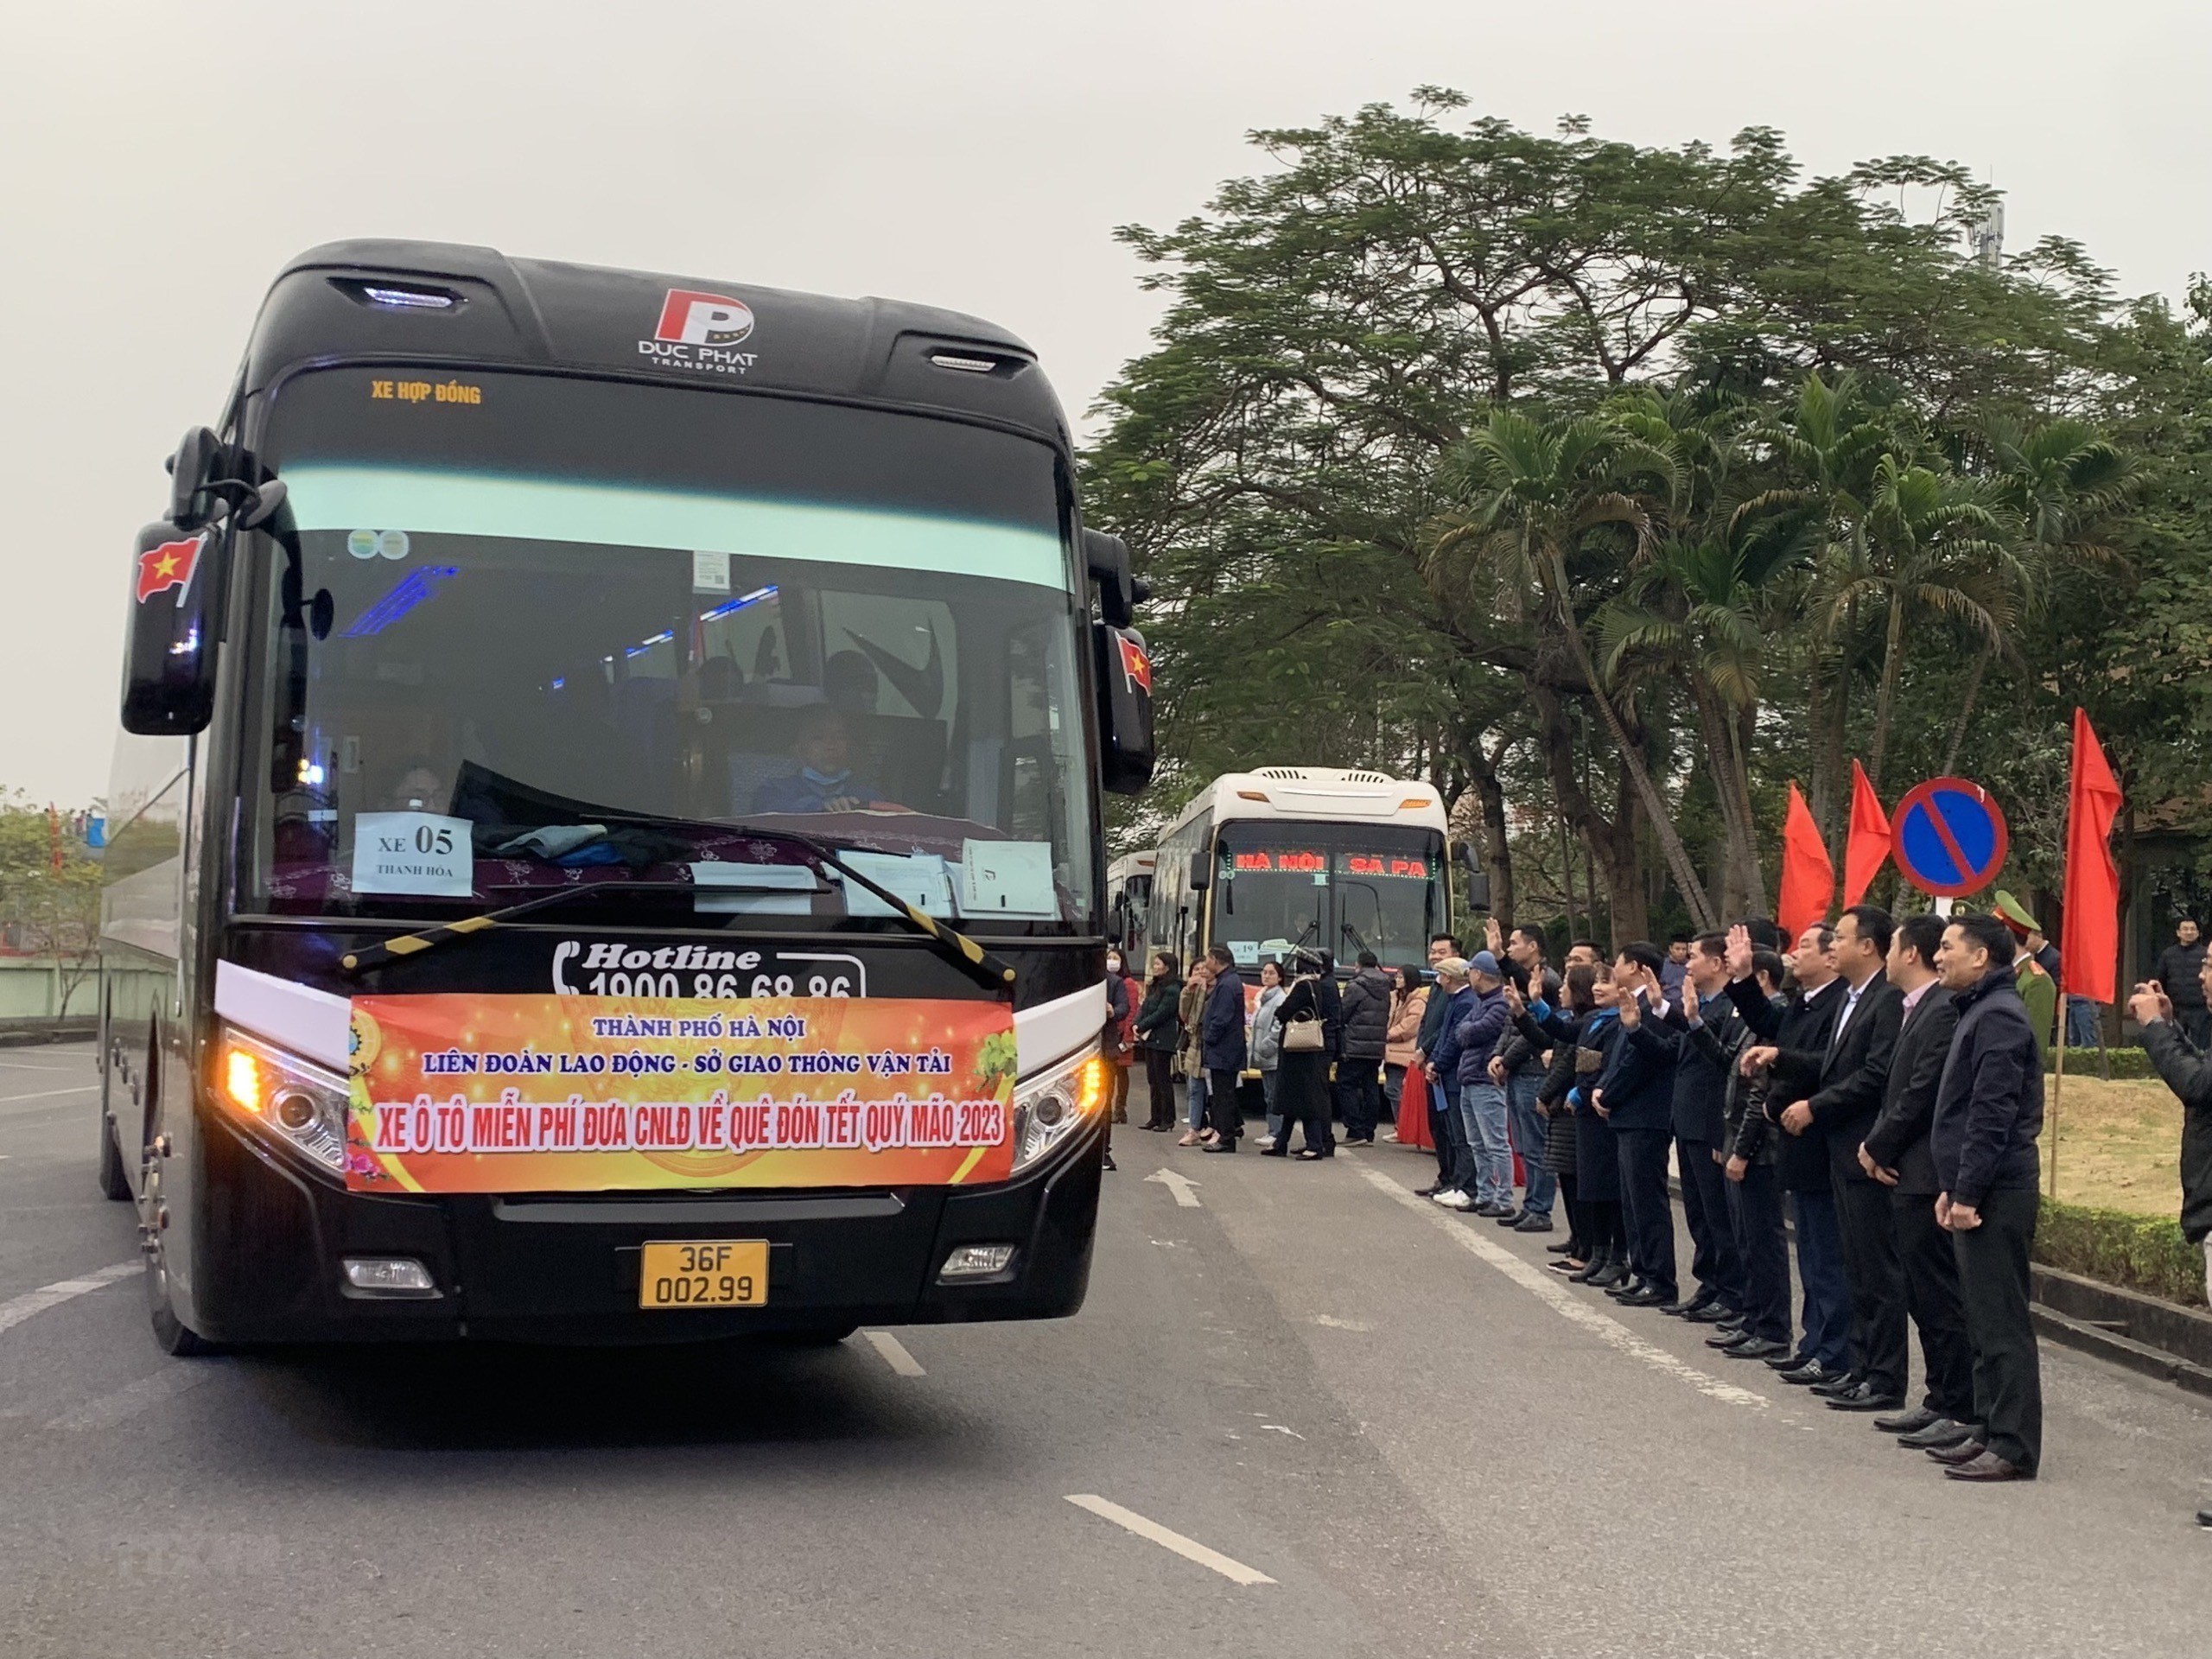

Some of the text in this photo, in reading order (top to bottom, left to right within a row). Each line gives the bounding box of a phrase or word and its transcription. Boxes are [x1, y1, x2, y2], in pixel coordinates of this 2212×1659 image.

[638, 340, 758, 366] DUC PHAT
[652, 357, 747, 374] TRANSPORT
[372, 380, 393, 398] XE
[397, 381, 431, 404] HỢP
[378, 825, 453, 855] XE 05
[376, 865, 453, 877] THANH HÓA
[1350, 857, 1384, 874] SA
[1391, 860, 1427, 877] PA
[582, 944, 761, 970] Hotline
[593, 1014, 805, 1042] THÀNH PHỐ HÀ NỘI
[423, 1050, 478, 1072] LIÊN
[486, 1050, 553, 1073] ĐOÀN
[559, 1055, 605, 1073] LAO
[612, 1051, 676, 1077] ĐỘNG
[694, 1049, 722, 1073] SỞ
[728, 1055, 782, 1073] GIAO
[789, 1052, 861, 1073] THÔNG
[867, 1052, 910, 1078] VẬN
[916, 1049, 951, 1073] TẢI
[378, 1090, 1001, 1148] XE Ô TÔ MIỄN PHÍ ĐƯA CNLĐ VỀ QUÊ ĐÓN TẾT QUÝ MÃO 2023
[679, 1246, 733, 1272] 36F
[655, 1275, 753, 1303] 002.99
